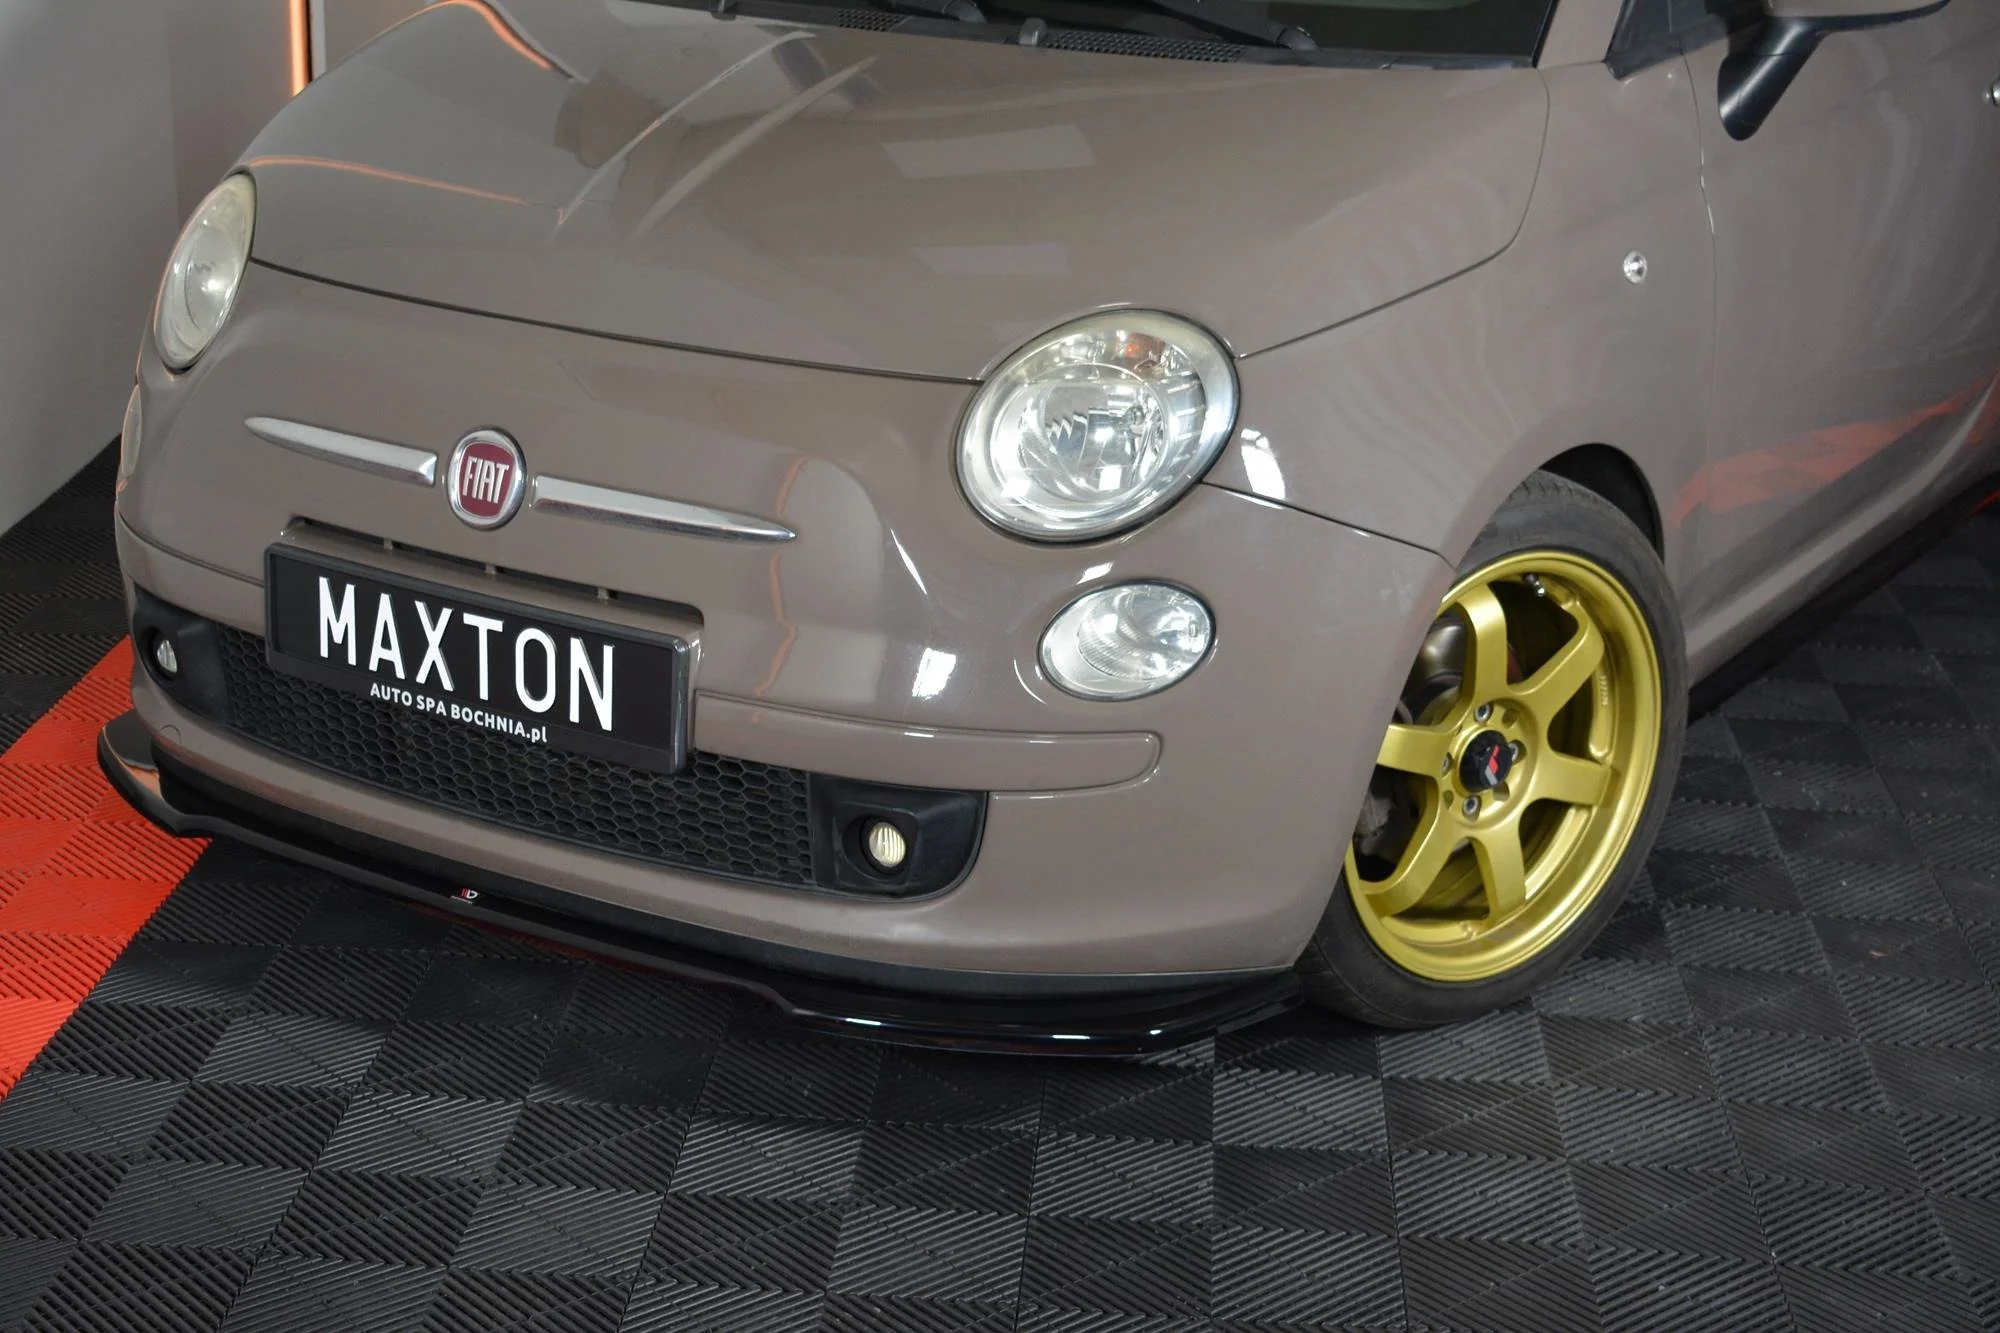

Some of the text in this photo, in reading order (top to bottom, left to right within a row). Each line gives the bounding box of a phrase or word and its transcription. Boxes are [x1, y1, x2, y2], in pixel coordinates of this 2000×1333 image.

[462, 455, 510, 505] FIAT
[318, 576, 616, 732] MAXTON
[369, 682, 548, 743] AUTO SPA BOCHNIA.pl
